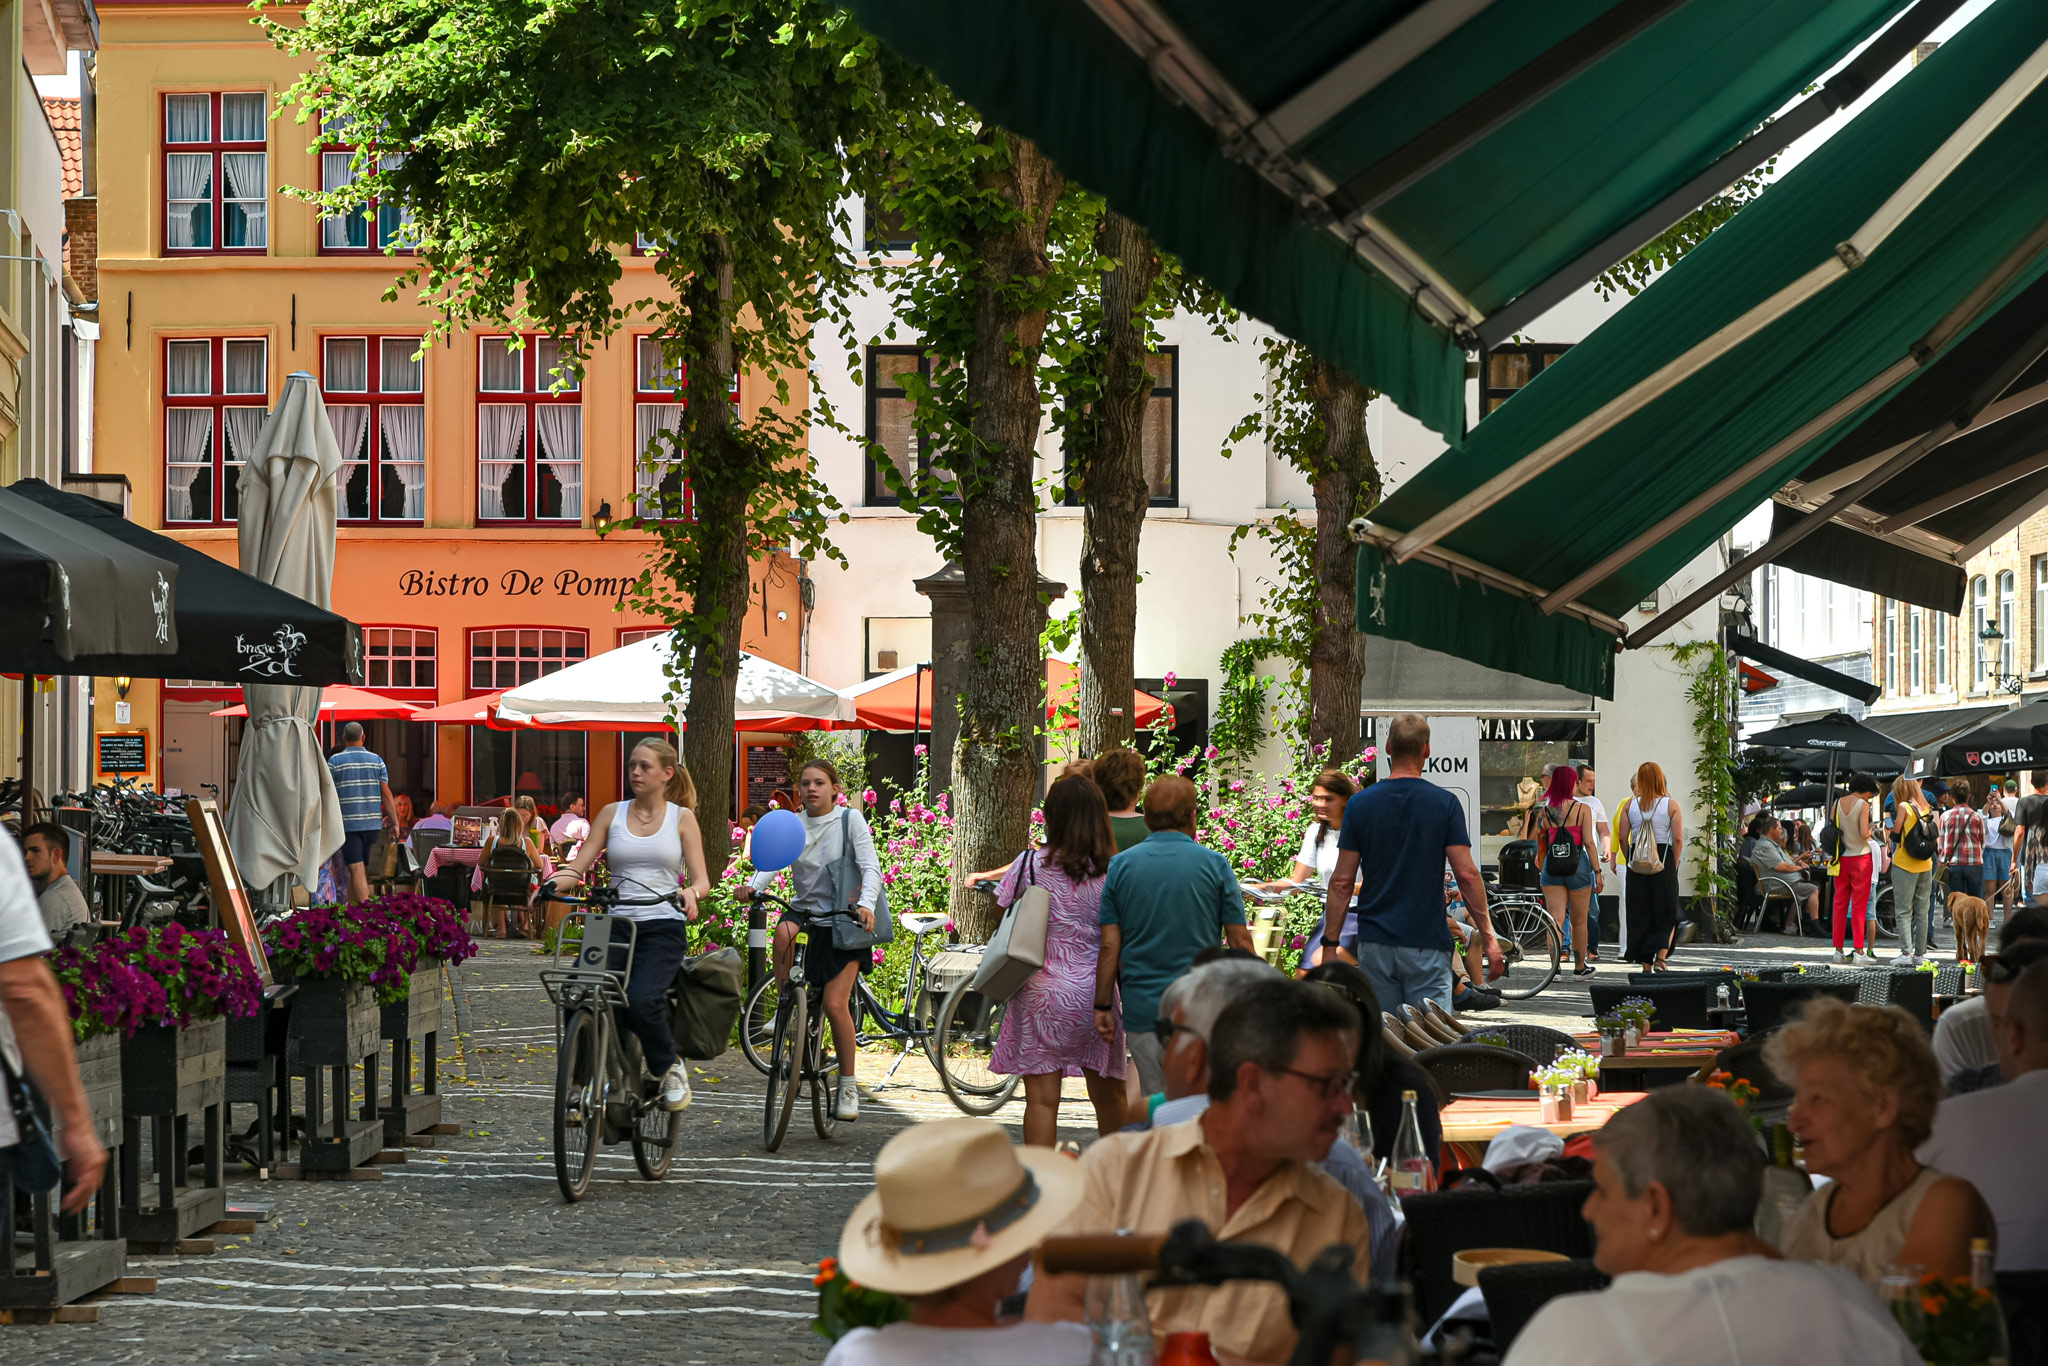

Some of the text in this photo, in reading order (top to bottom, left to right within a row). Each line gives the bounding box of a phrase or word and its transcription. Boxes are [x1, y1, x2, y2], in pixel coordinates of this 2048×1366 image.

[399, 569, 638, 606] Bistro De Pomp
[1387, 757, 1469, 774] KOM
